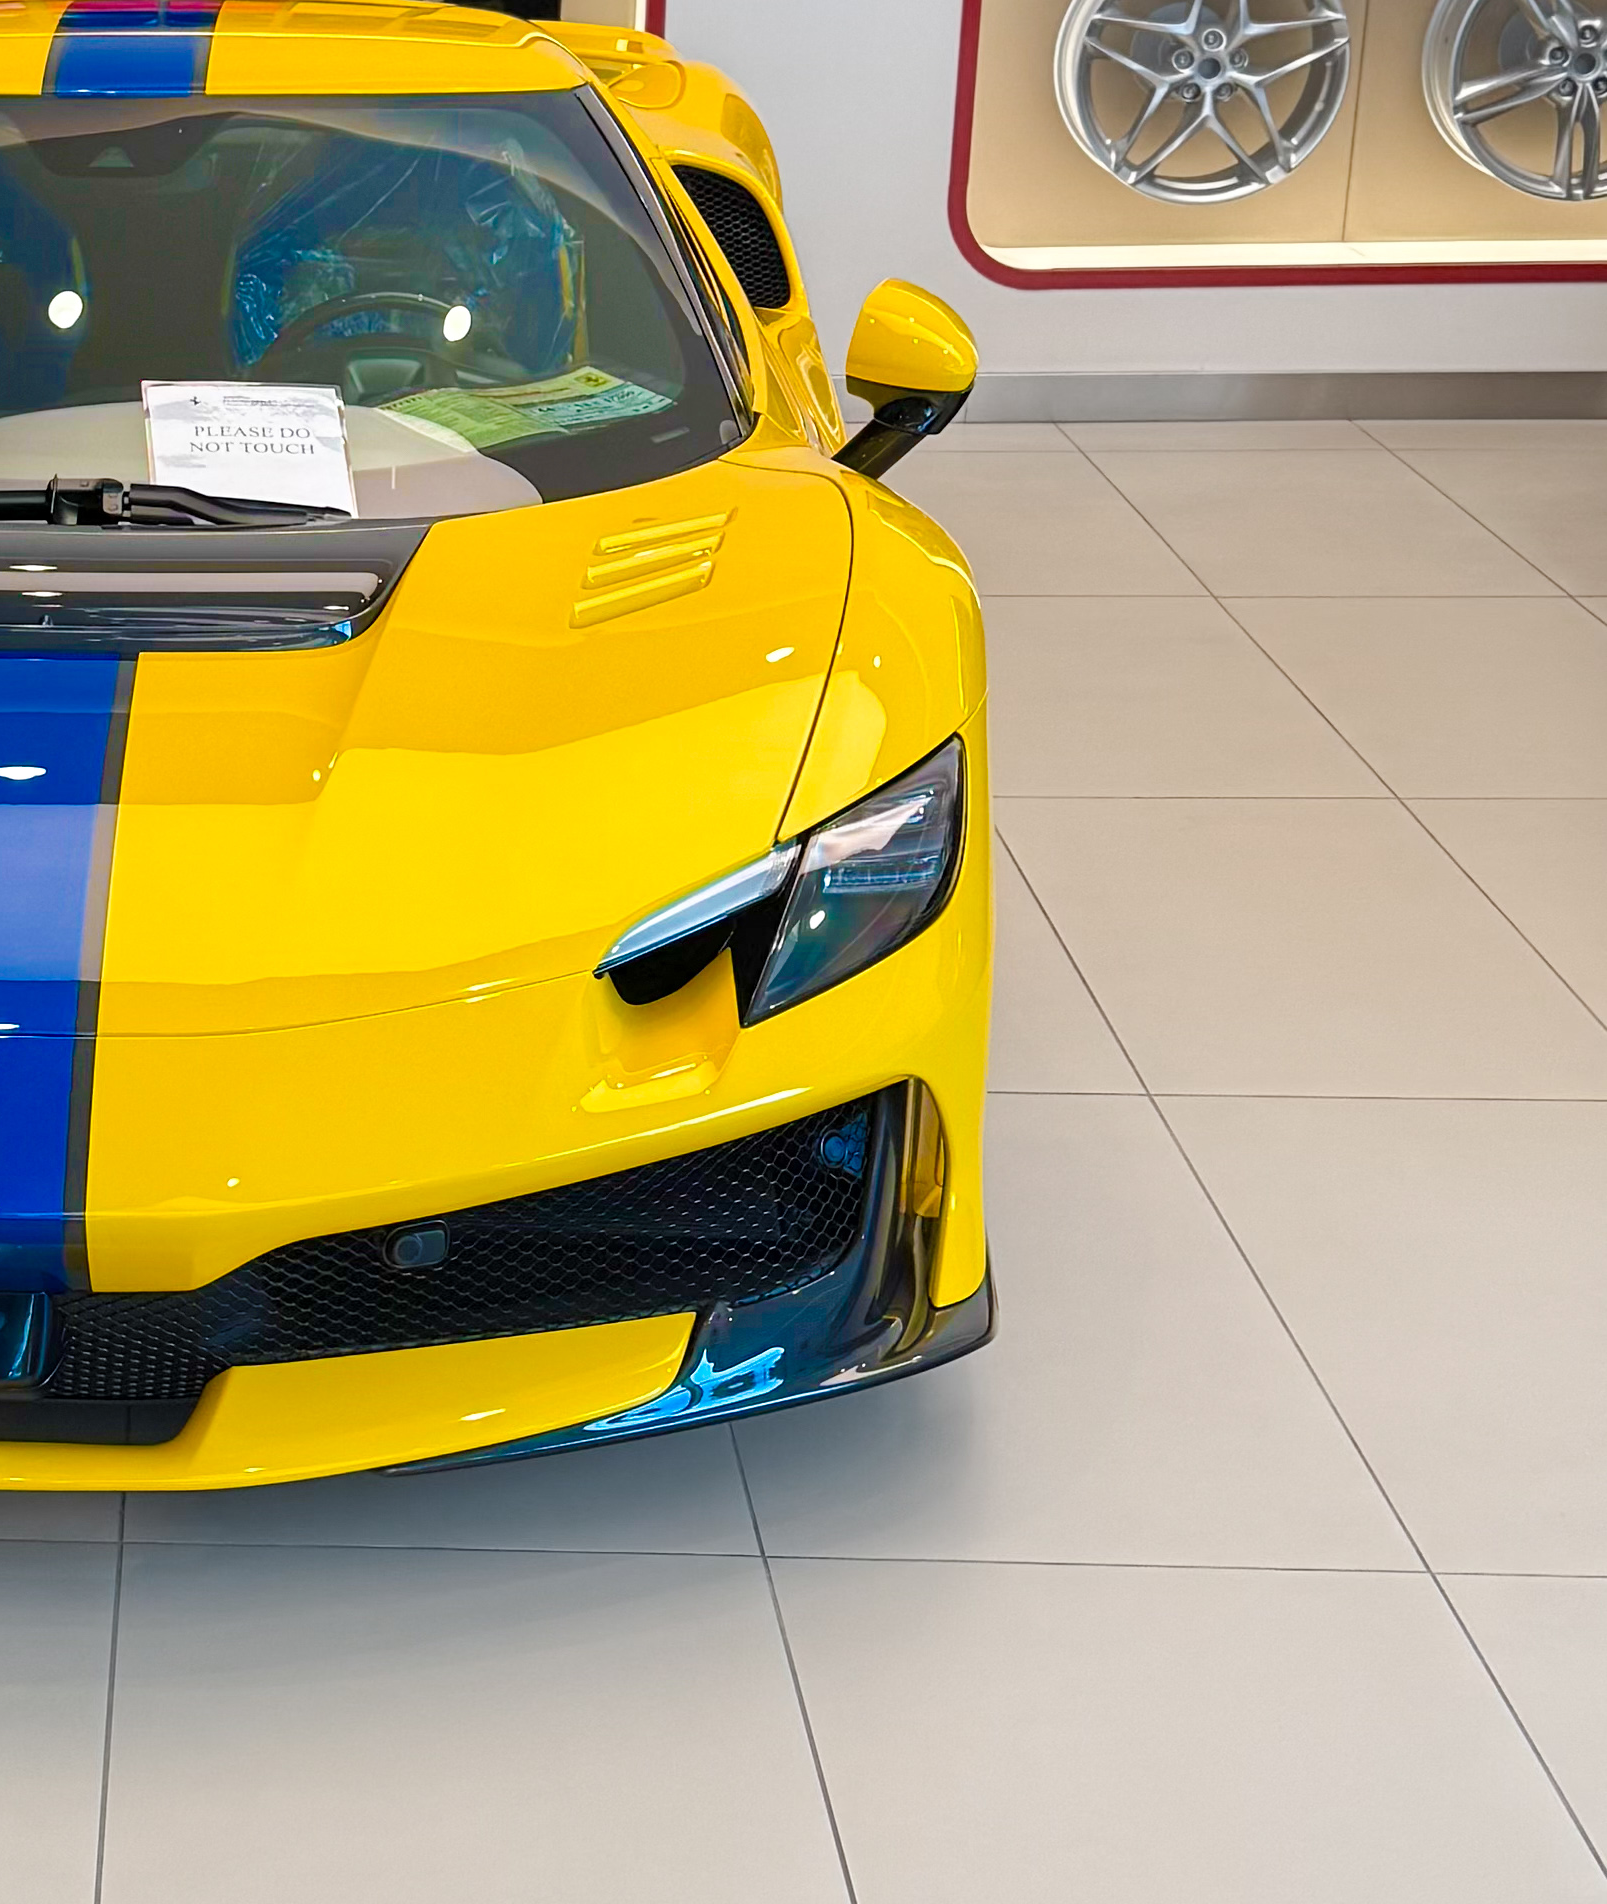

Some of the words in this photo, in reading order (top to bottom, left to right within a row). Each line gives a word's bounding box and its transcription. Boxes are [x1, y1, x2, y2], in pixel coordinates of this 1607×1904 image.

[194, 425, 274, 438] PLEASE
[280, 427, 311, 439] DO
[190, 441, 233, 453] NOT
[239, 442, 315, 455] TOUCH
